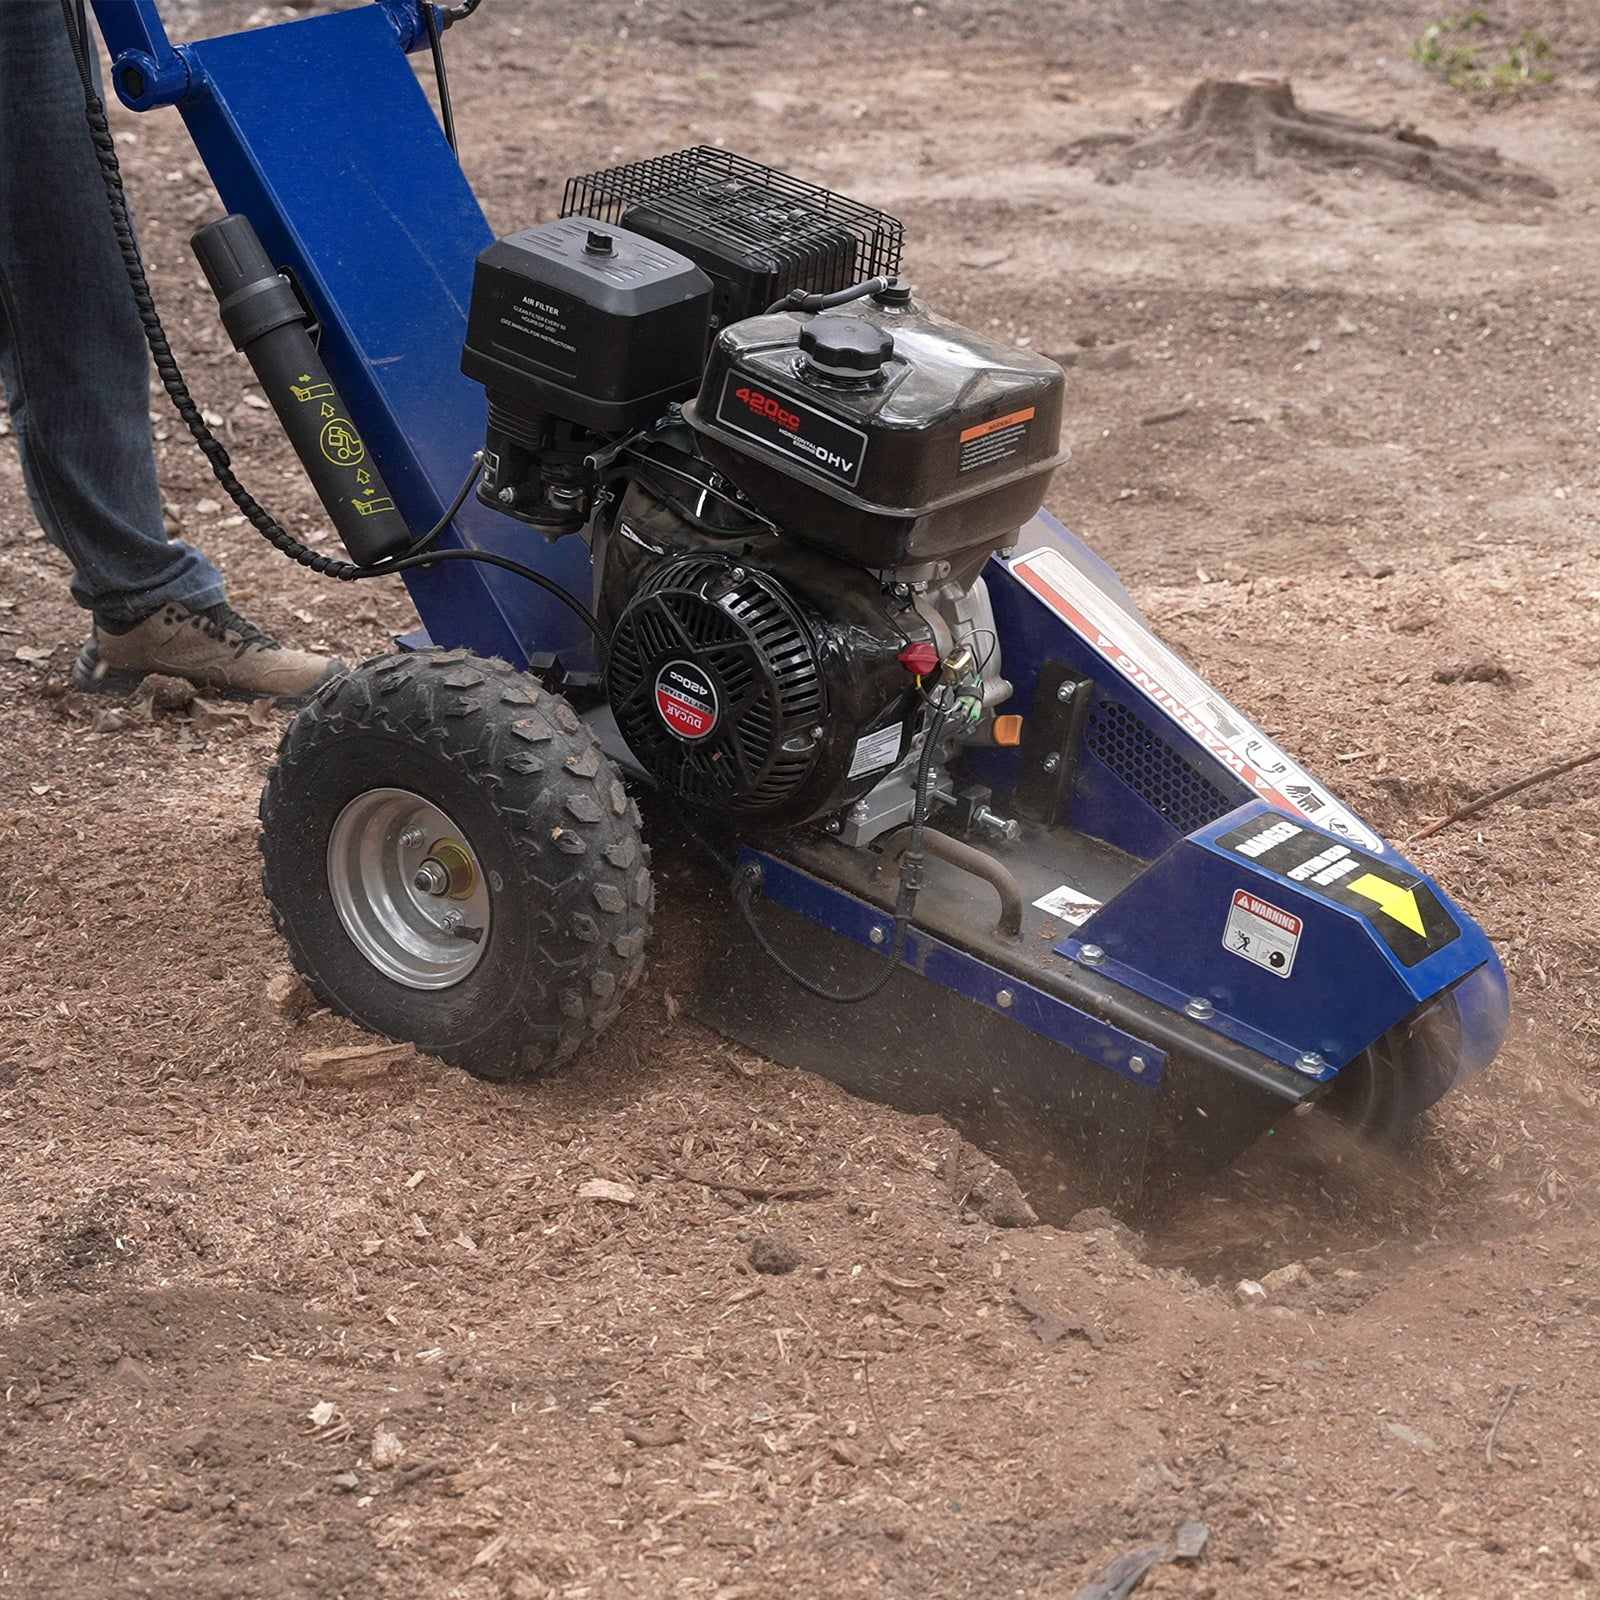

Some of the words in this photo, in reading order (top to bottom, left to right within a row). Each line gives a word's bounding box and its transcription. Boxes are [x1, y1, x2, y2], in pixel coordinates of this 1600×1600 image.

[522, 296, 535, 306] AIR
[535, 301, 560, 316] FILTER
[736, 388, 800, 428] 420cc
[815, 446, 853, 472] OHV
[670, 671, 708, 695] 420cc
[666, 704, 703, 729] DUCAR
[1116, 655, 1244, 770] WARNING
[1234, 821, 1303, 858] DANGER
[1250, 899, 1296, 930] WARNING
